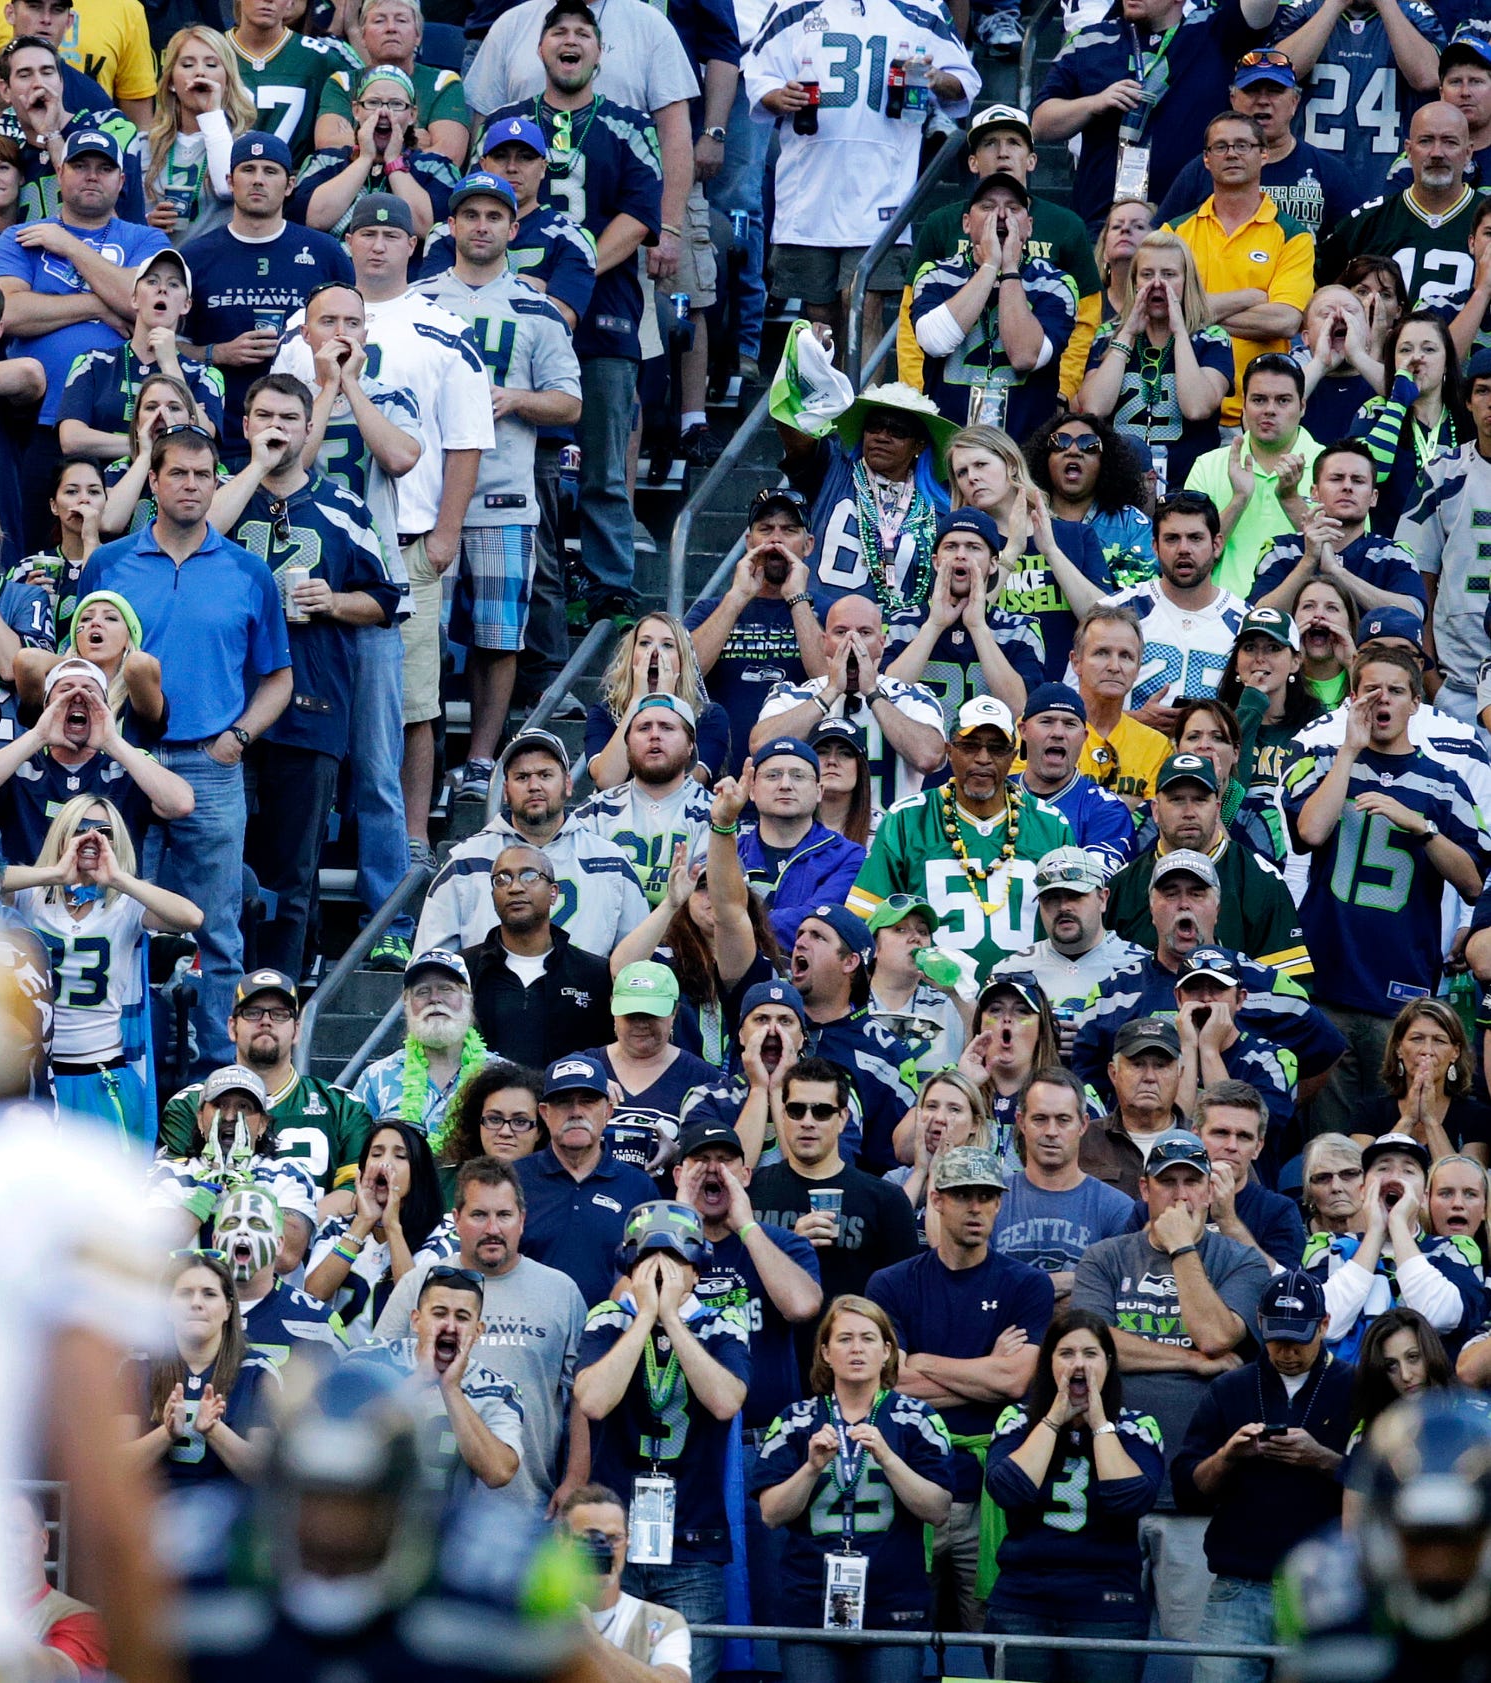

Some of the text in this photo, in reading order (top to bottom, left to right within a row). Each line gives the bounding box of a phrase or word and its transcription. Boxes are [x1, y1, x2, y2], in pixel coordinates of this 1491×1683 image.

[821, 33, 886, 112] 31
[1309, 63, 1401, 154] 24
[208, 295, 307, 308] SEAHAWK
[226, 287, 298, 295] SEATTLE
[257, 258, 269, 276] 3
[314, 424, 367, 499] 3
[238, 521, 321, 609] 12
[1007, 569, 1046, 591] IKE
[1130, 641, 1228, 712] 25
[1330, 799, 1414, 913] 15
[925, 859, 1039, 955] 50
[999, 1218, 1091, 1248] SEATTLE
[480, 1336, 527, 1346] TBALL
[481, 1321, 546, 1338] HAWKS
[1115, 1301, 1170, 1313] SUPER
[810, 1466, 895, 1536] 25
[1043, 1456, 1090, 1532] 3
